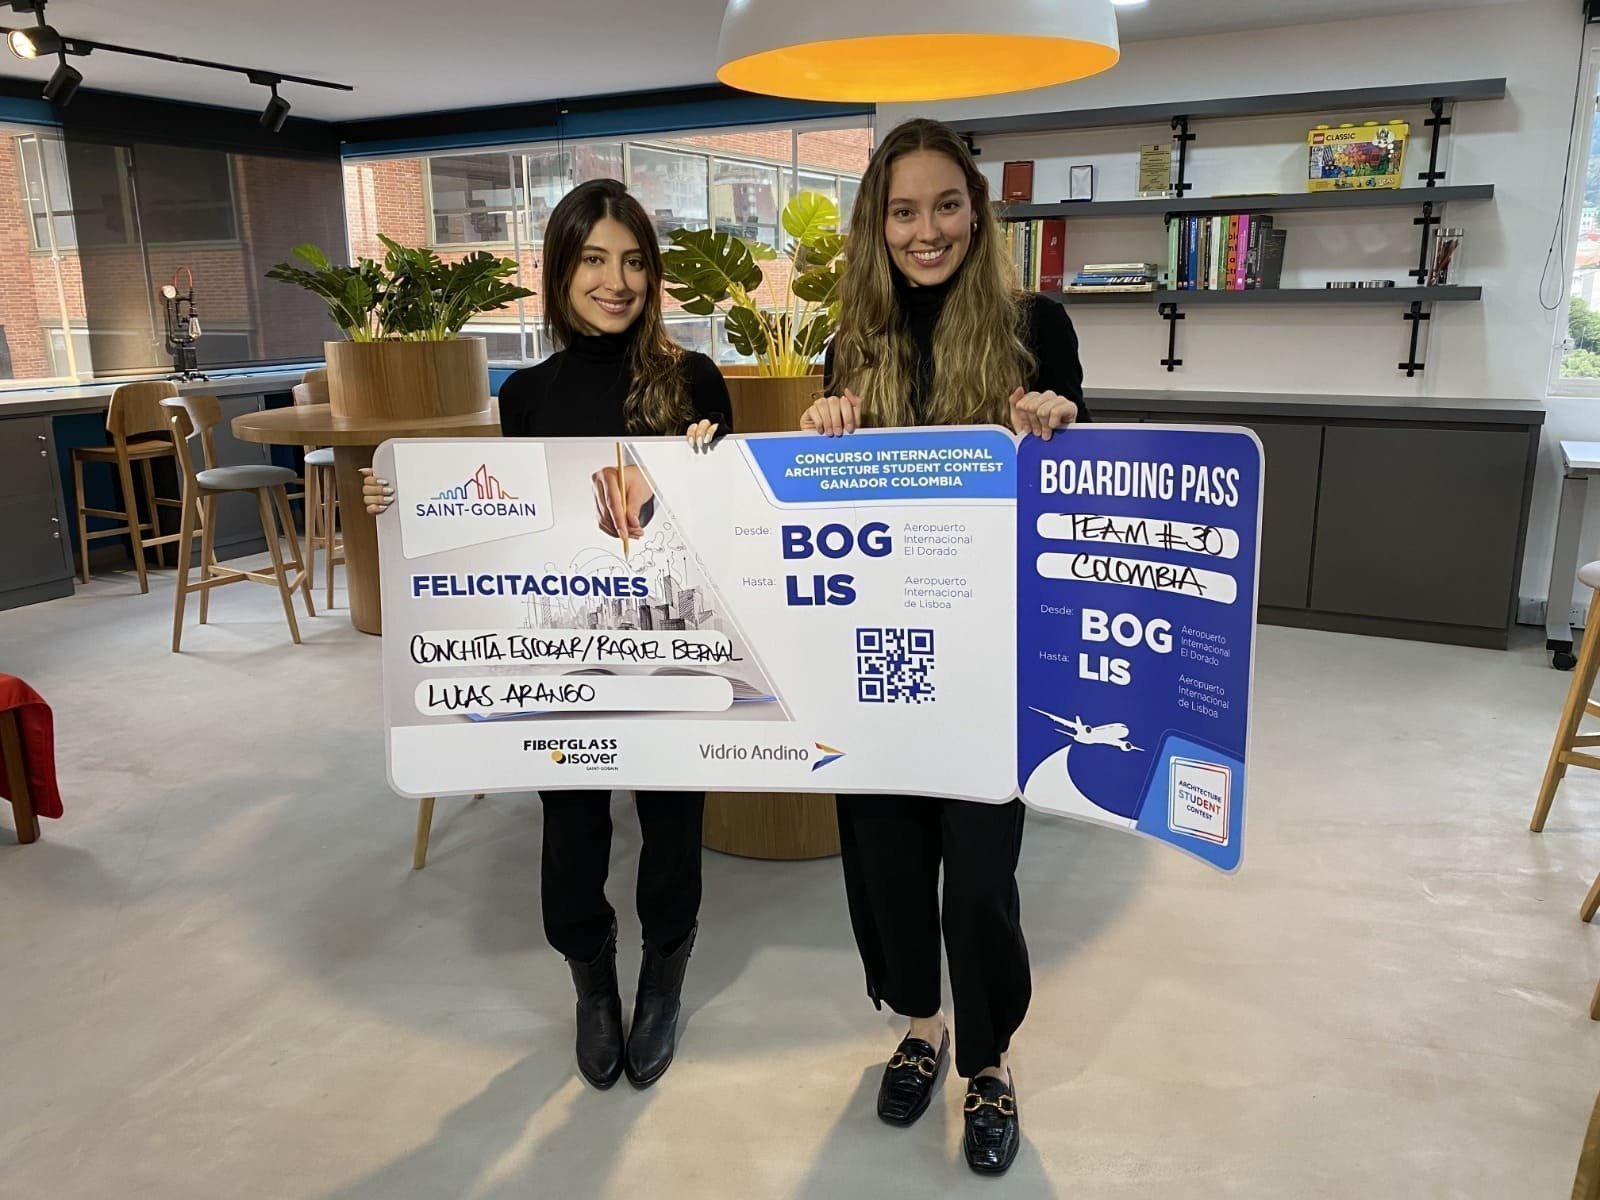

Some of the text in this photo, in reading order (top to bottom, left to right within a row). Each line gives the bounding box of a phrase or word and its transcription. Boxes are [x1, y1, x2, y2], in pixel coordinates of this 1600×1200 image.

[1326, 133, 1355, 141] CLASSIC
[795, 449, 992, 464] CONCURSO INTERNACIONAL
[785, 462, 1003, 477] ARCHITECTURE STUDENT CONTEST
[820, 475, 963, 489] GANADOR COLOMBIA
[1040, 459, 1239, 507] BOARDING PASS
[416, 503, 536, 517] SAINT-GOBAIN
[735, 526, 772, 536] Desde:
[904, 523, 966, 534] Aeropuerto
[1061, 513, 1223, 555] TEAM #30
[781, 522, 892, 559] BOG
[904, 535, 973, 545] Internacional
[904, 547, 958, 556] El Dorado
[742, 577, 776, 587] Hasta:
[905, 577, 967, 588] Aeropuerto
[1071, 552, 1207, 596] COLOMBIA
[412, 575, 649, 598] FELICITACIONES
[786, 574, 857, 606] LIS
[904, 588, 973, 599] Internacional
[904, 600, 952, 609] de Lisboa
[1040, 604, 1074, 616] Desde:
[1081, 608, 1173, 654] BOG
[1181, 625, 1226, 644] Aeropuerto
[411, 634, 506, 664] CONCHITA
[1181, 638, 1230, 657] Internacional
[1039, 651, 1070, 663] Hasta:
[1180, 649, 1219, 666] El Dorado
[1079, 653, 1131, 686] LIS
[1178, 674, 1225, 696] Aeropuerto
[429, 683, 595, 709] LUCAS ARANGO
[1178, 687, 1229, 709] Internacional
[1178, 699, 1218, 718] de Lisboa
[699, 743, 808, 761] Vidrio Andino
[1179, 780, 1222, 803] ARCHITECTURE
[1178, 789, 1221, 815] STUDENT
[1186, 804, 1213, 821] CONTEST
